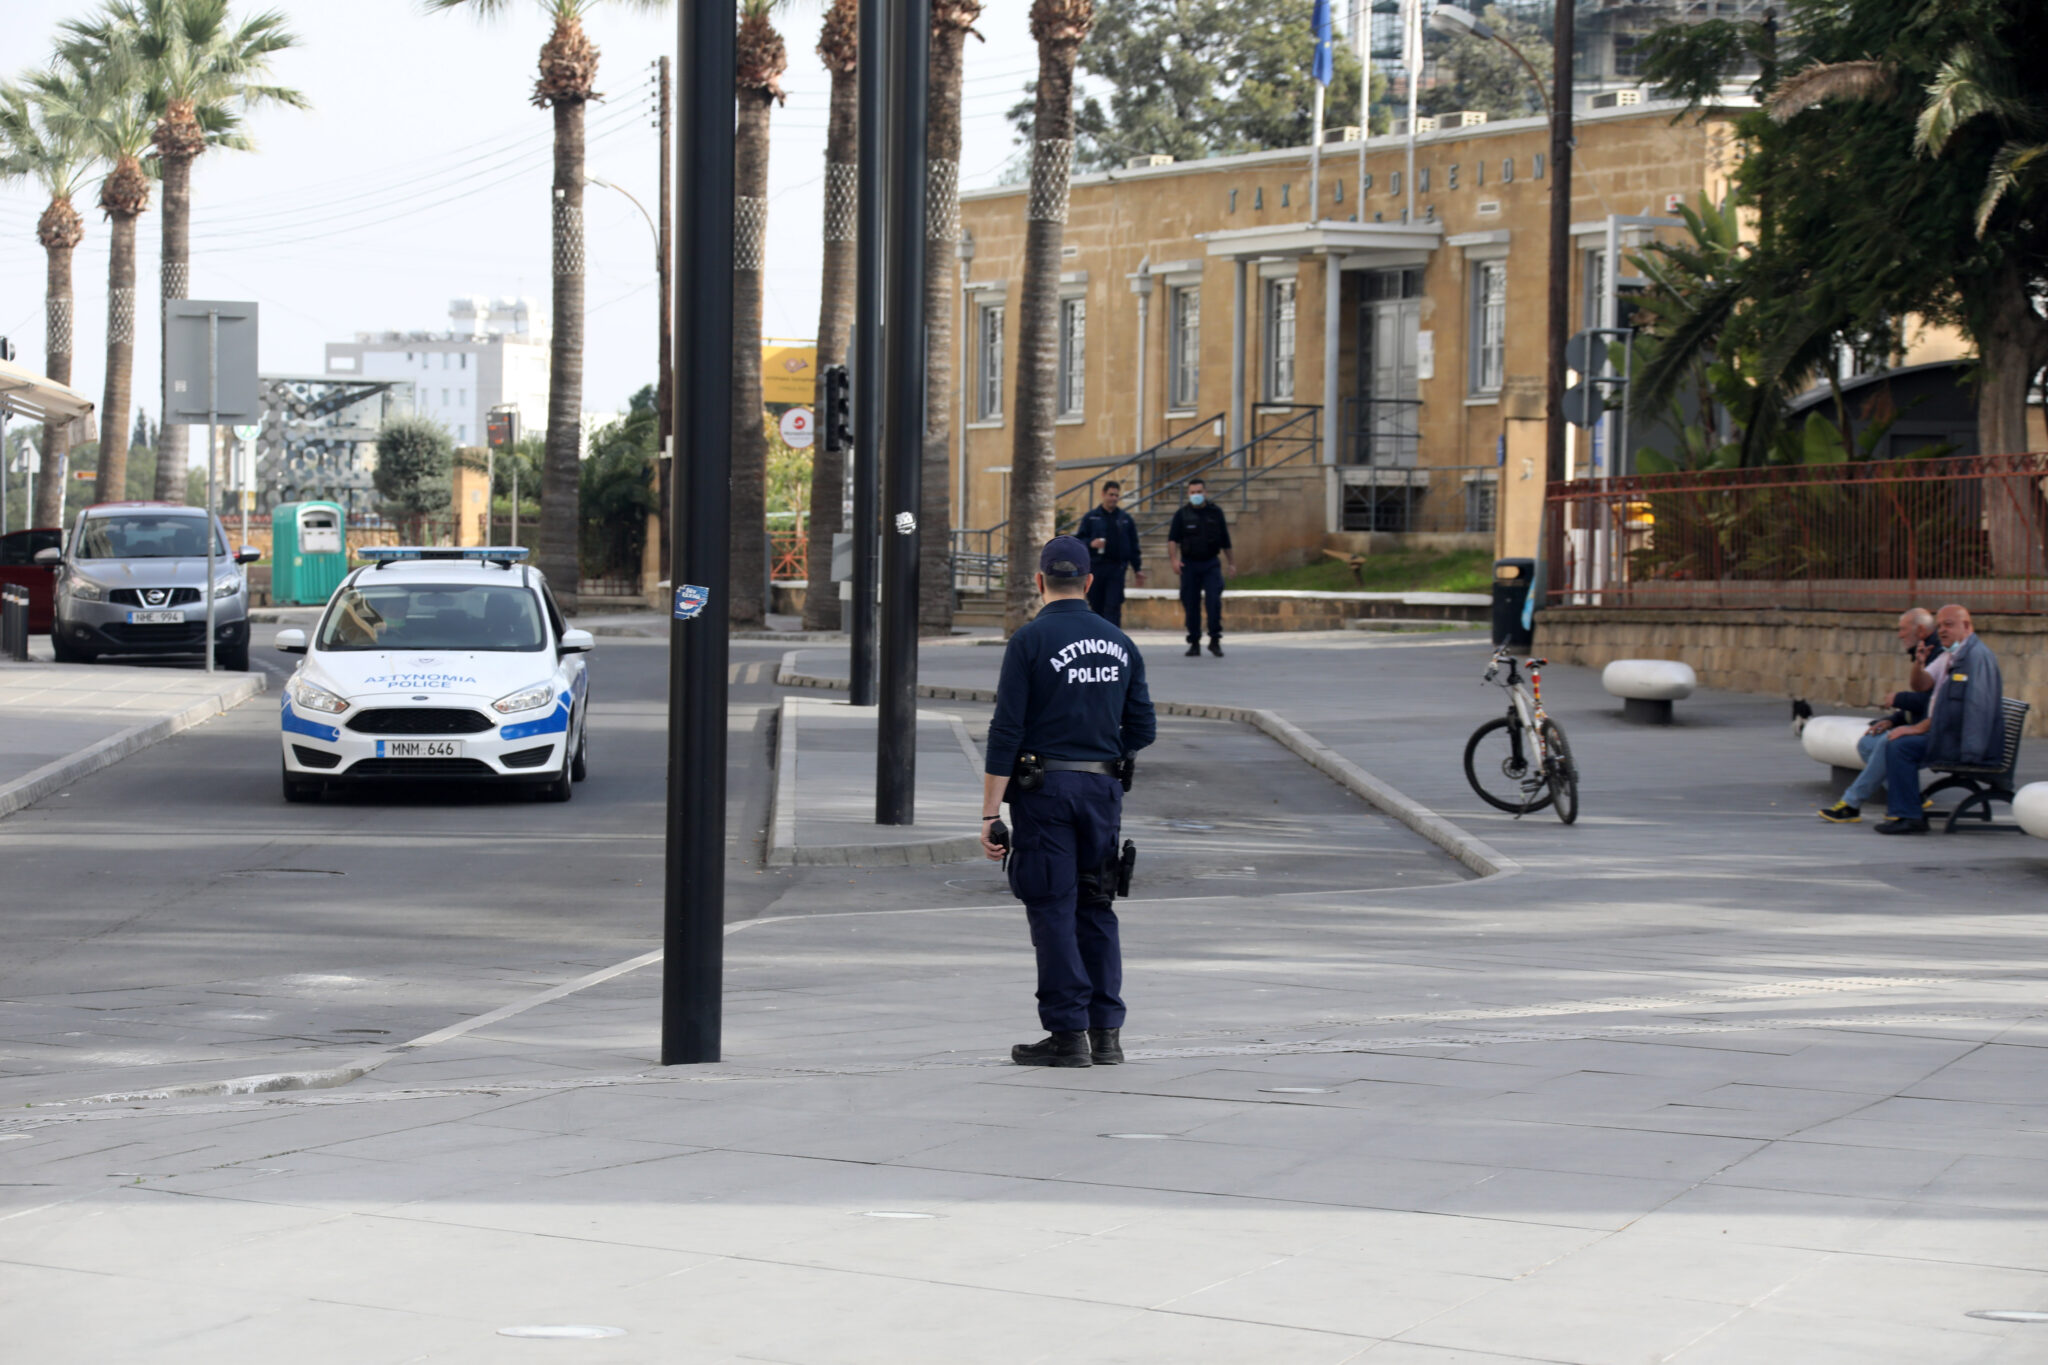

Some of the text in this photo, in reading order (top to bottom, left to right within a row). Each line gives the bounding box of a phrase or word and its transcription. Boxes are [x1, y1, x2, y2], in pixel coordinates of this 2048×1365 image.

[1229, 153, 1545, 214] ΤΑΧΔΡΟΜΕΙΟΝ
[1049, 638, 1129, 673] ΑΣΤΥΝΟΜΙΑ
[364, 674, 476, 683] ΑΣΤΥΝΟΜΙΑ
[1068, 666, 1118, 683] POLICE
[392, 743, 419, 755] MNM
[427, 743, 454, 755] 646
